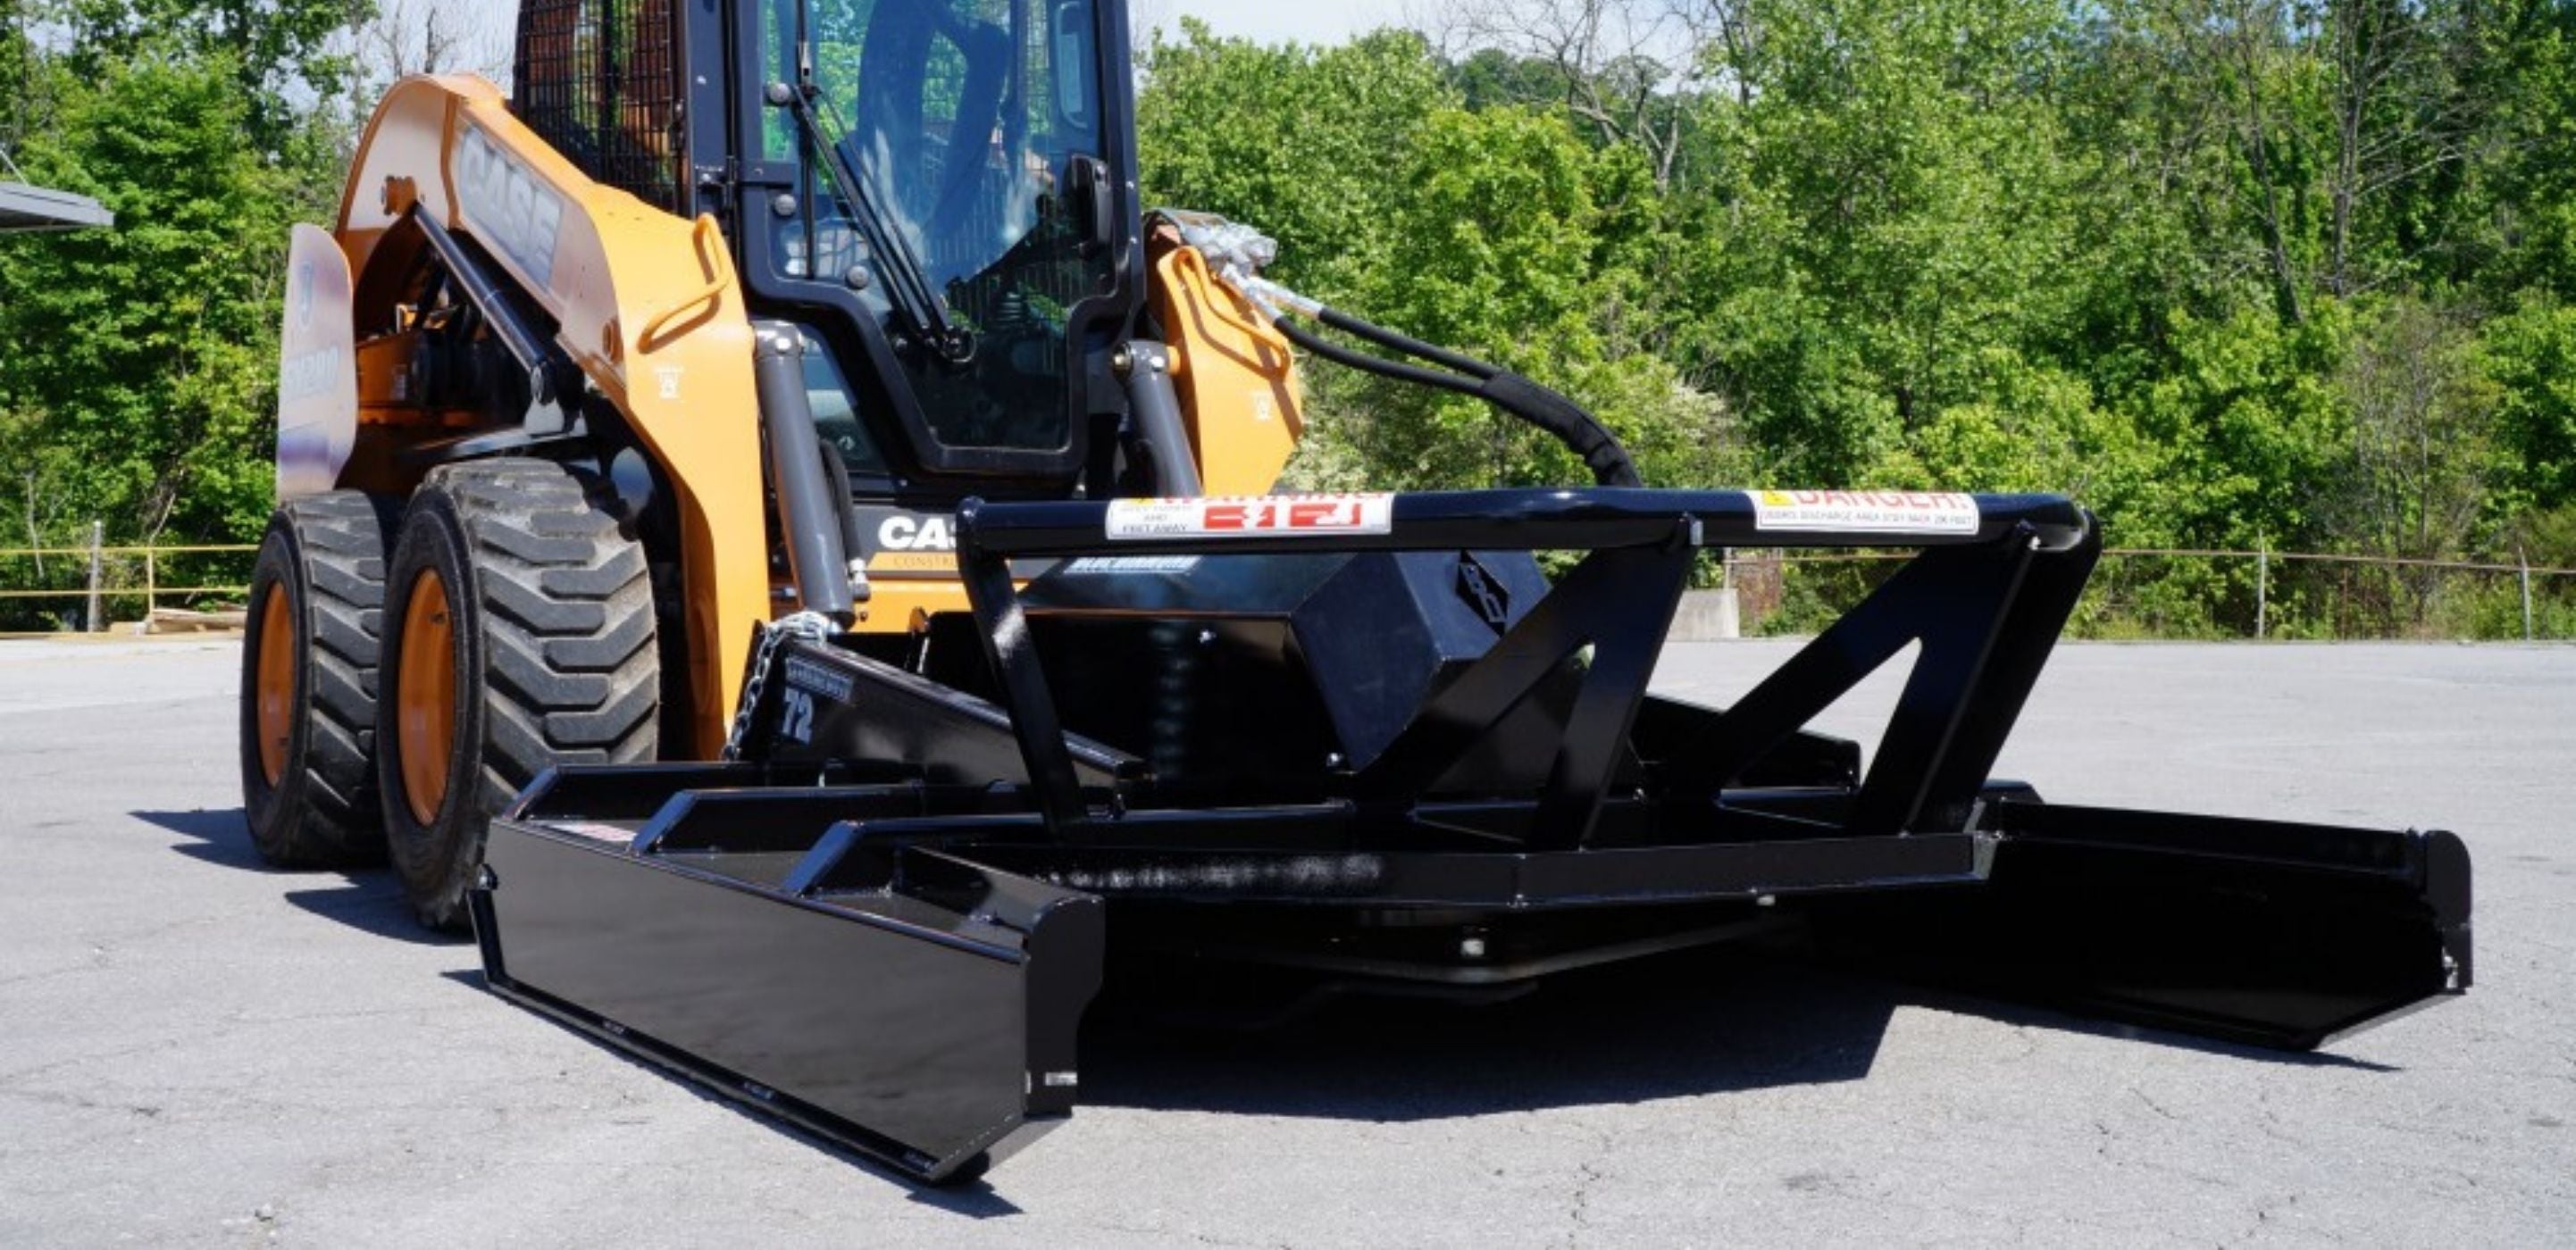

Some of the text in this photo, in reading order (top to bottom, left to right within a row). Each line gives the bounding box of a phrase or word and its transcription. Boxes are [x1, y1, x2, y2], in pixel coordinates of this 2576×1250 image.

[459, 128, 561, 285] CASE
[878, 515, 957, 550] CA
[782, 687, 813, 744] 72
